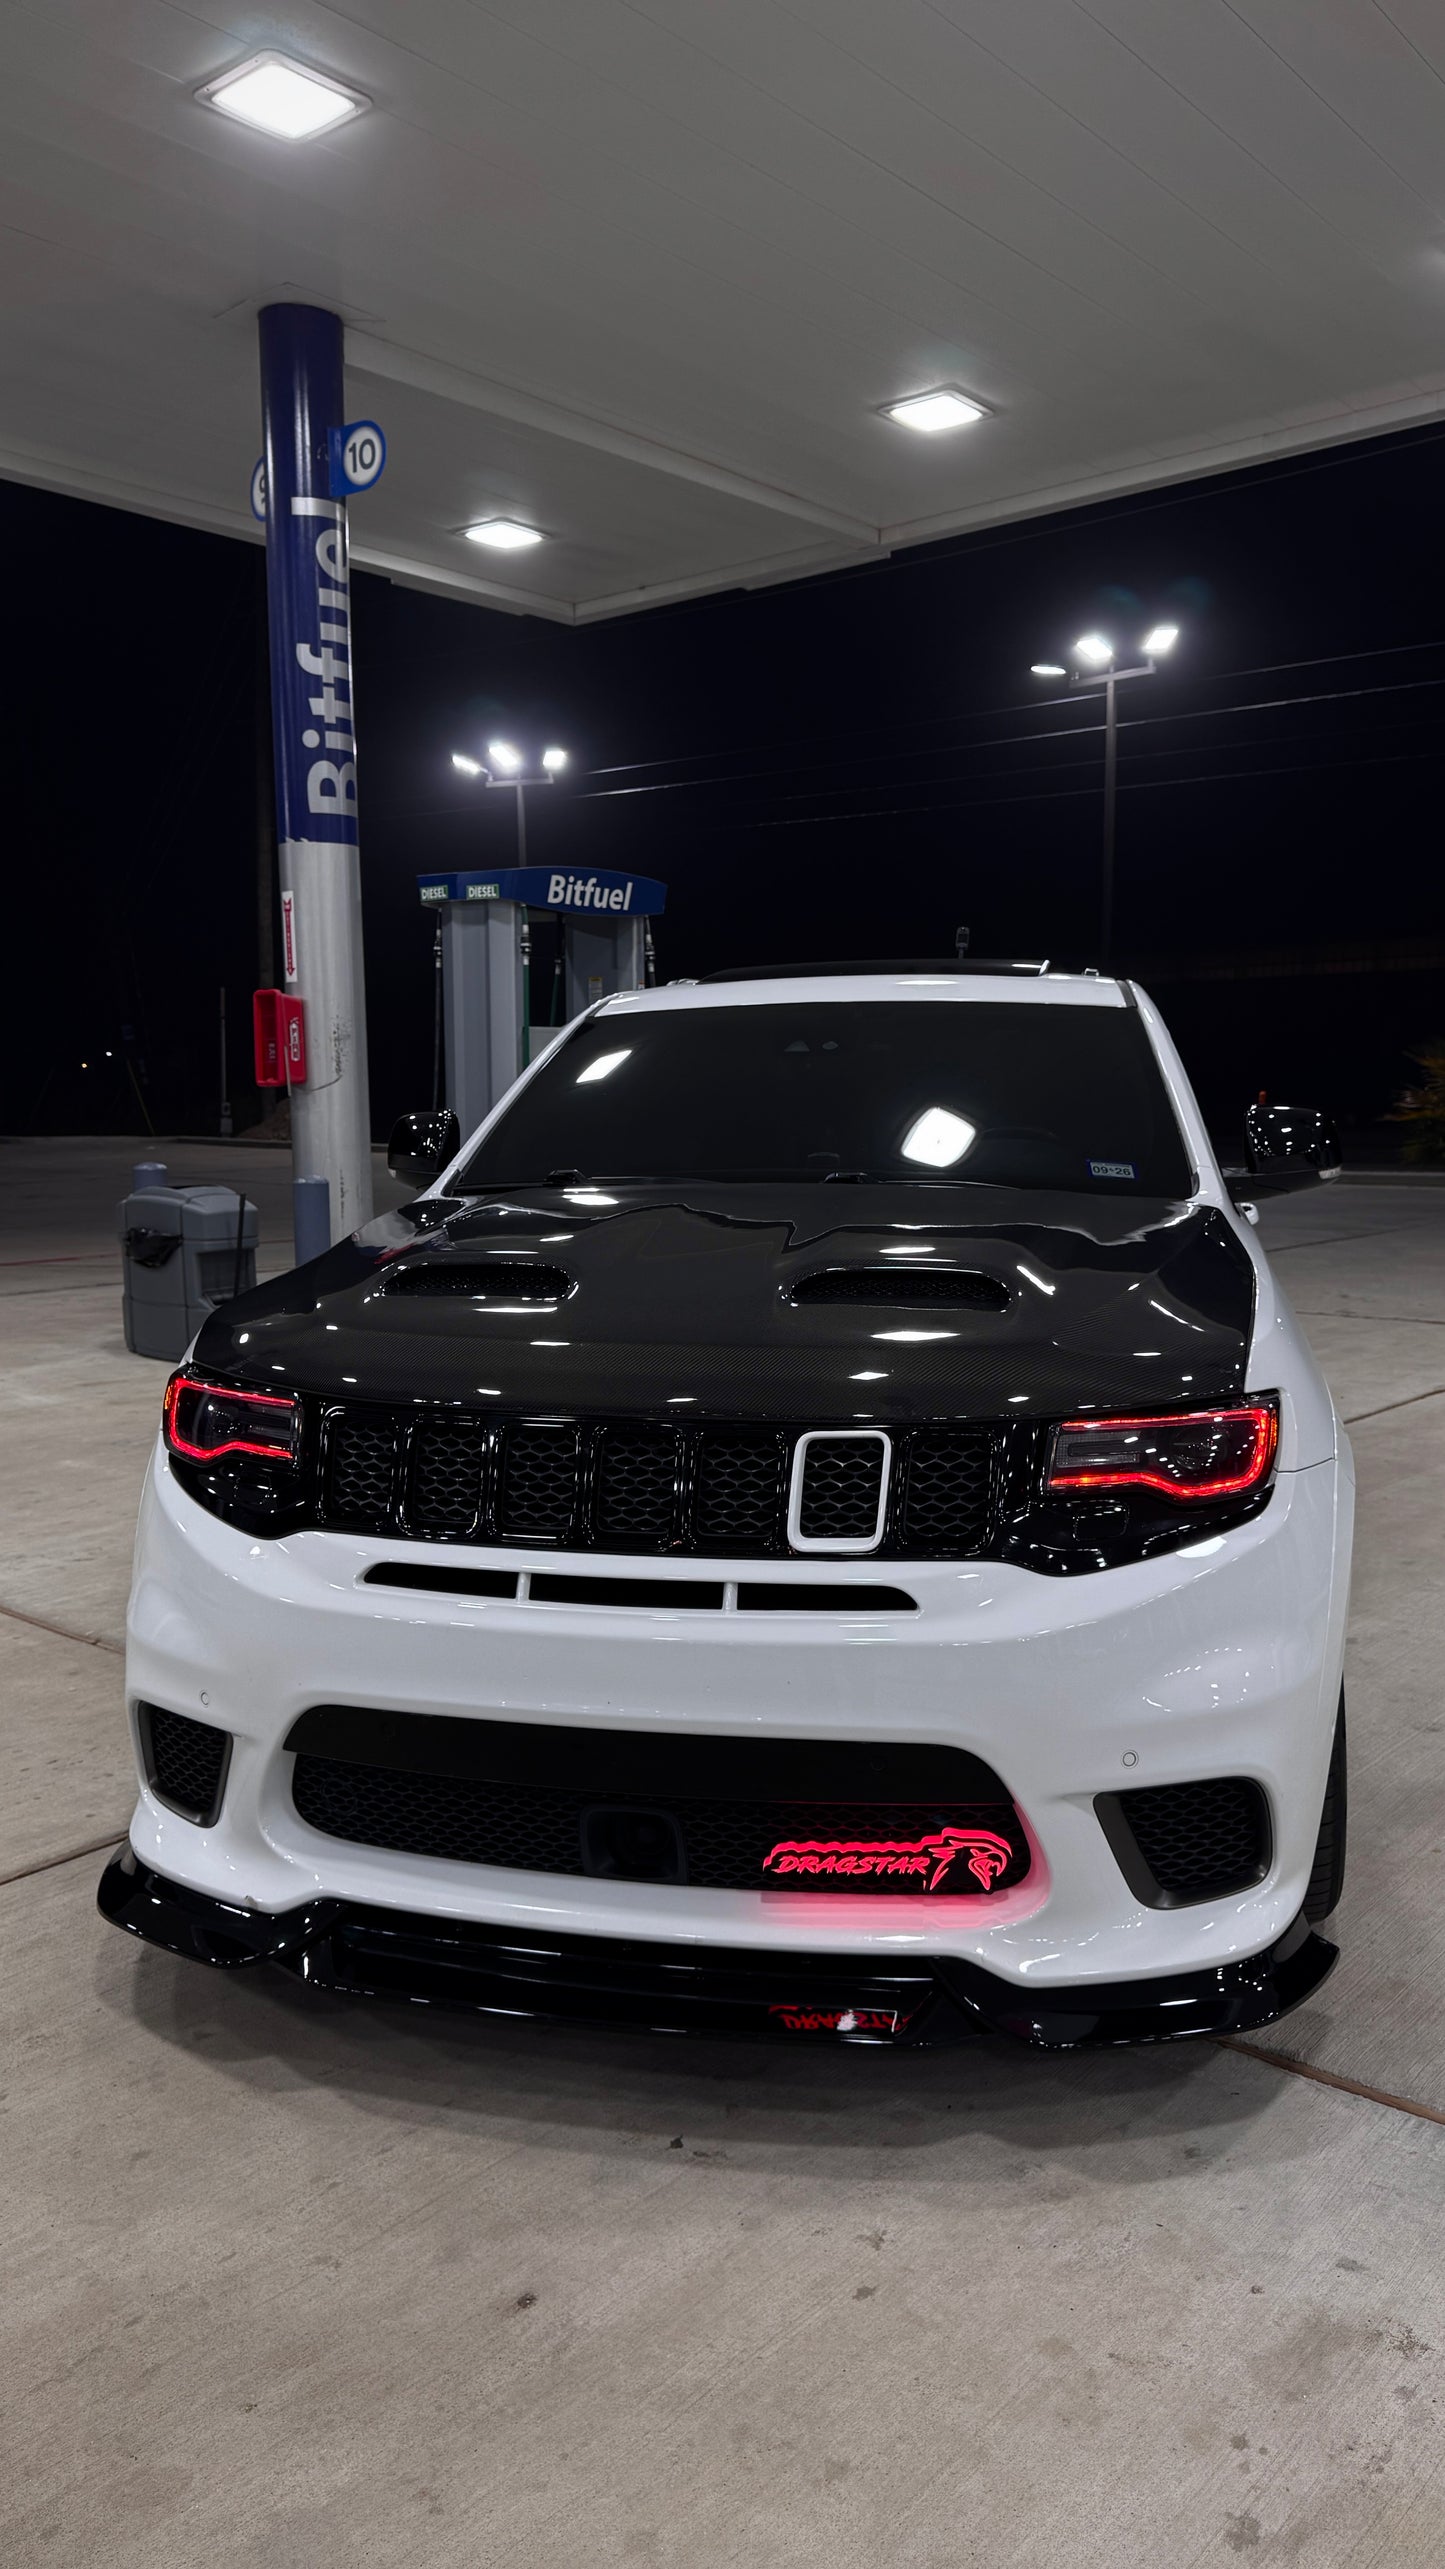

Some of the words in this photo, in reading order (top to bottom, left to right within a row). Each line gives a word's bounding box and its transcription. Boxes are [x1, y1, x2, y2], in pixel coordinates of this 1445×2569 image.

[348, 438, 377, 474] 10
[290, 496, 358, 819] Bitfuel
[421, 886, 447, 900] DIESEL
[468, 885, 497, 898] DIESEL
[547, 874, 634, 912] Bitfuel
[771, 1854, 931, 1876] DRAGSTAR
